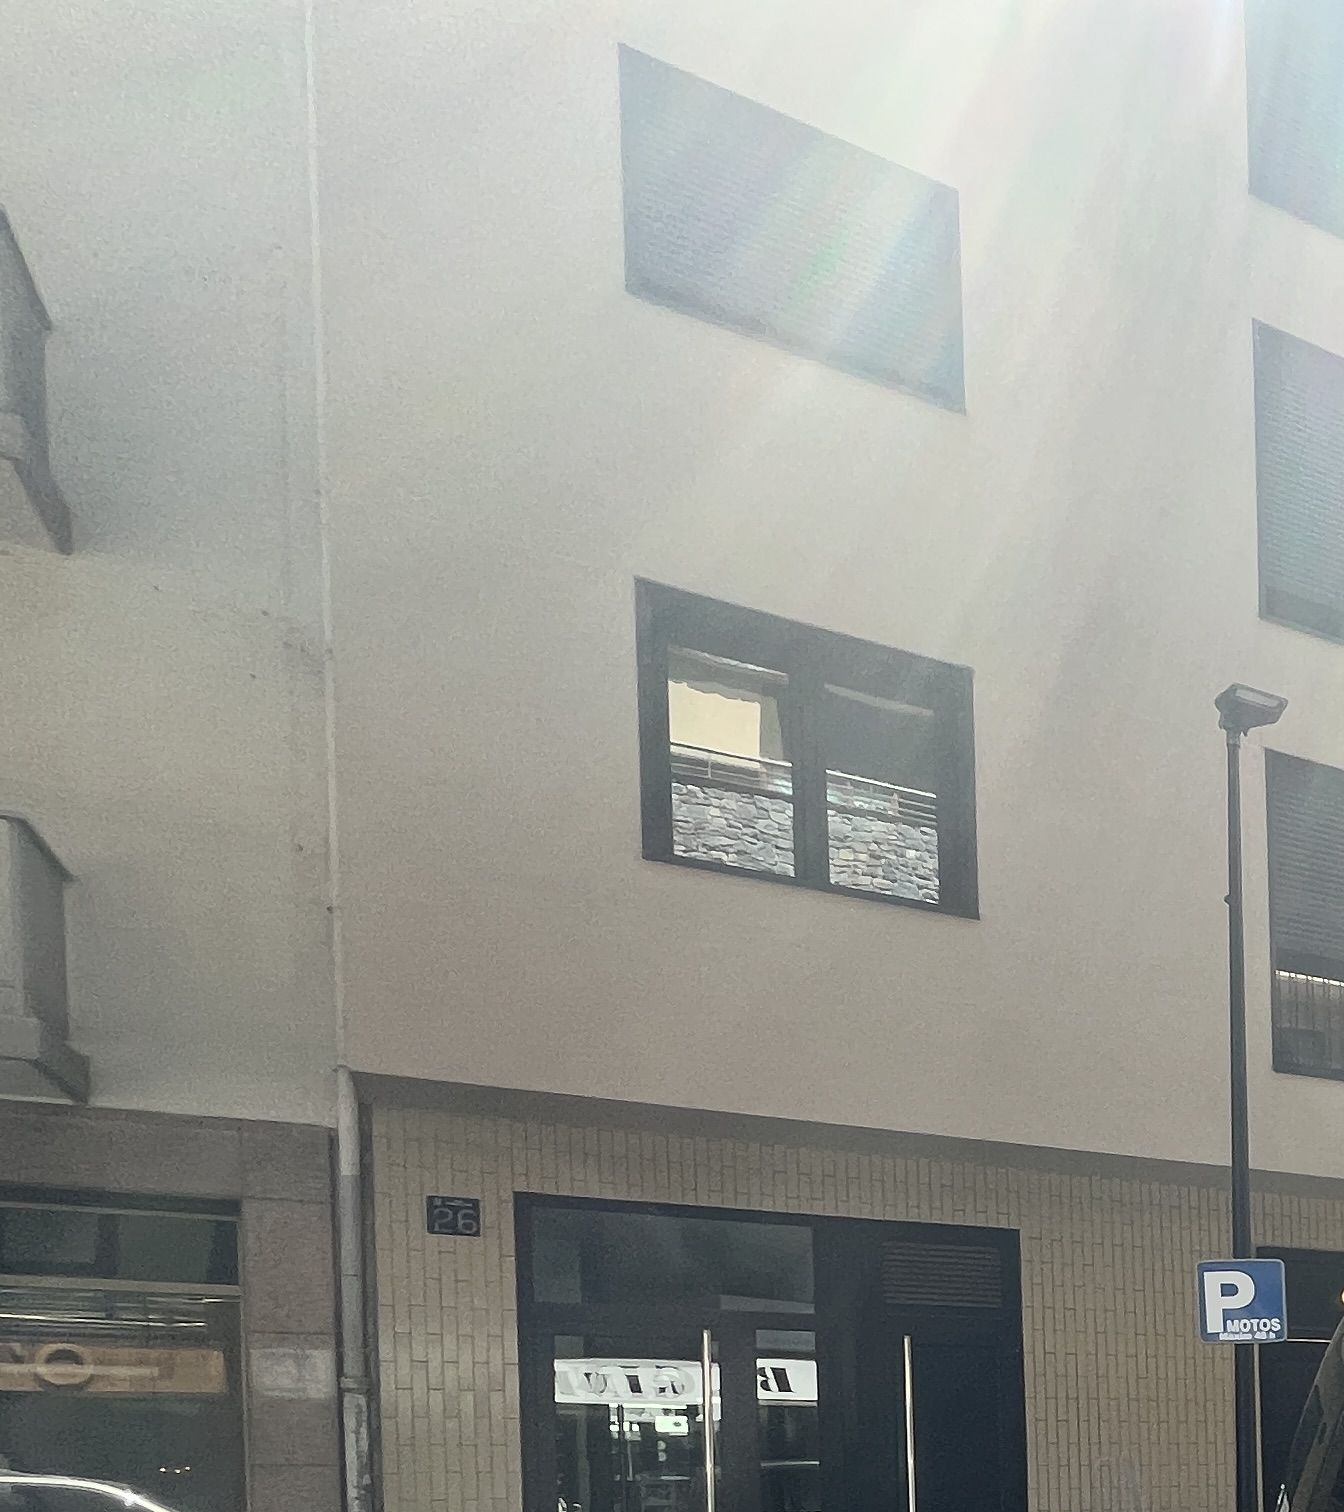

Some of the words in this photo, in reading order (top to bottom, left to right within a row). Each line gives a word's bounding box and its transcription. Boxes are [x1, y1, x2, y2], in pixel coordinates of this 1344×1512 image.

[433, 1207, 478, 1233] 26
[1203, 1269, 1255, 1334] P
[1226, 1318, 1281, 1333] MOTOS
